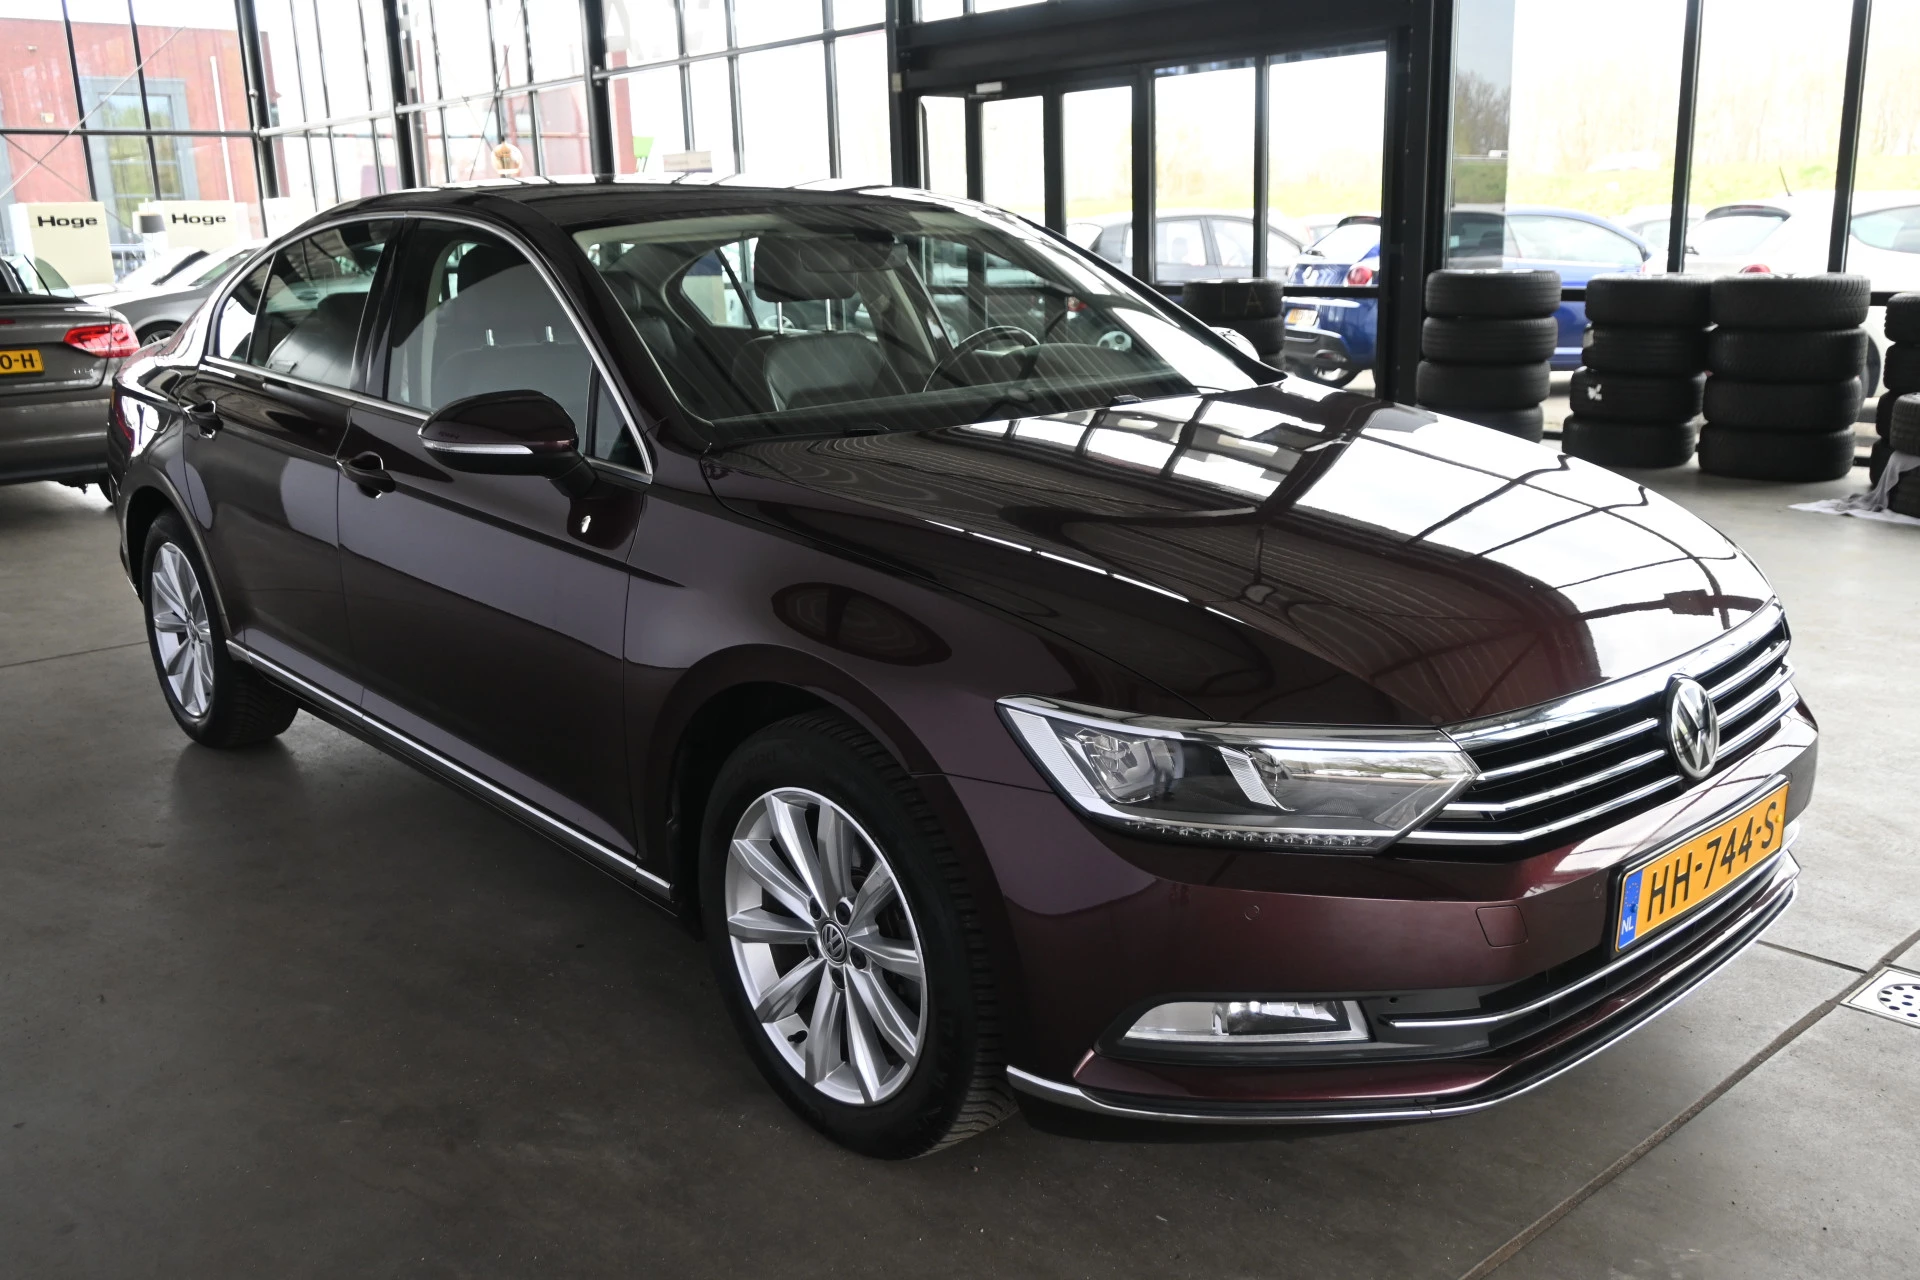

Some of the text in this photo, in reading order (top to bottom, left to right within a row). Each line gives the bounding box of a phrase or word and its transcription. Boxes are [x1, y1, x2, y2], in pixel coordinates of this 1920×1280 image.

[37, 215, 98, 229] Hoge
[171, 213, 227, 226] Hoge
[1647, 801, 1777, 923] HH-744-S
[1621, 916, 1634, 936] NL
